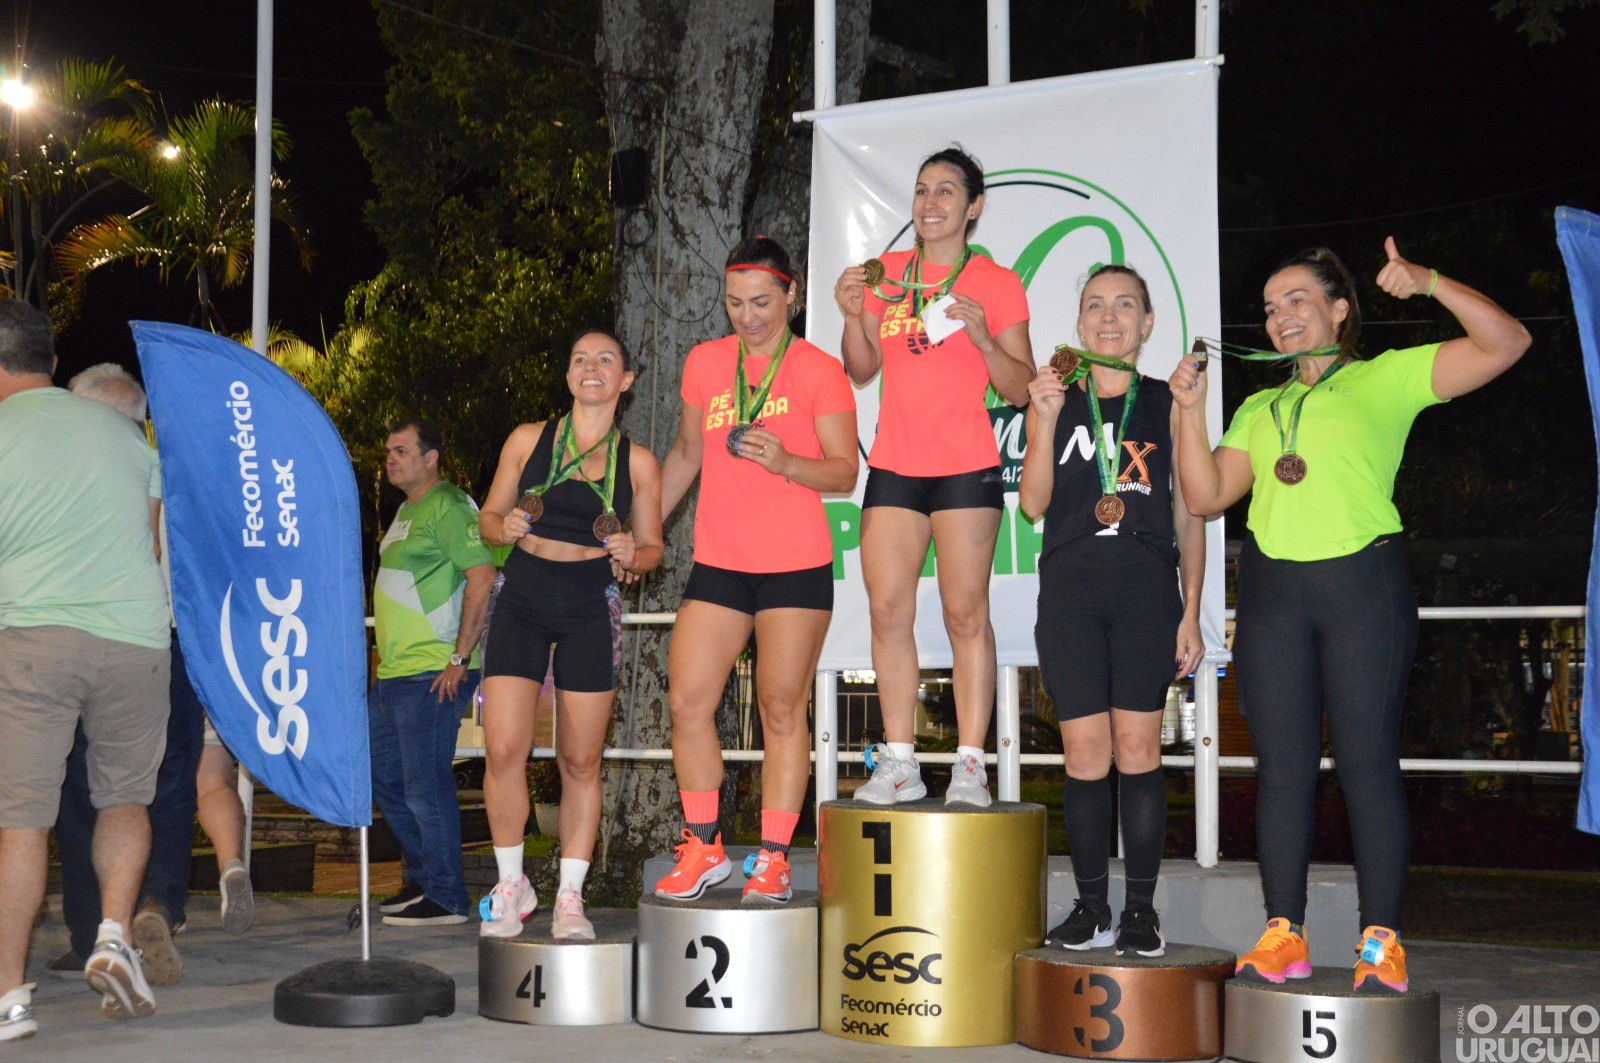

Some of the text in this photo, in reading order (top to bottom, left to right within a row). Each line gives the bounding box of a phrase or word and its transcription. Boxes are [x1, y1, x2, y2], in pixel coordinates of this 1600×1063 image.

[884, 299, 910, 319] PÉ
[709, 388, 731, 413] PÉ
[226, 381, 266, 548] Fecomércio
[272, 459, 300, 548] Senac
[1115, 482, 1152, 495] RUNNER
[862, 821, 893, 917] 1
[516, 965, 546, 1008] 4
[685, 935, 733, 1008] 2
[841, 994, 942, 1017] Fecomércio
[841, 1017, 889, 1038] Senac
[1073, 973, 1125, 1053] 3
[1302, 1009, 1337, 1059] 5
